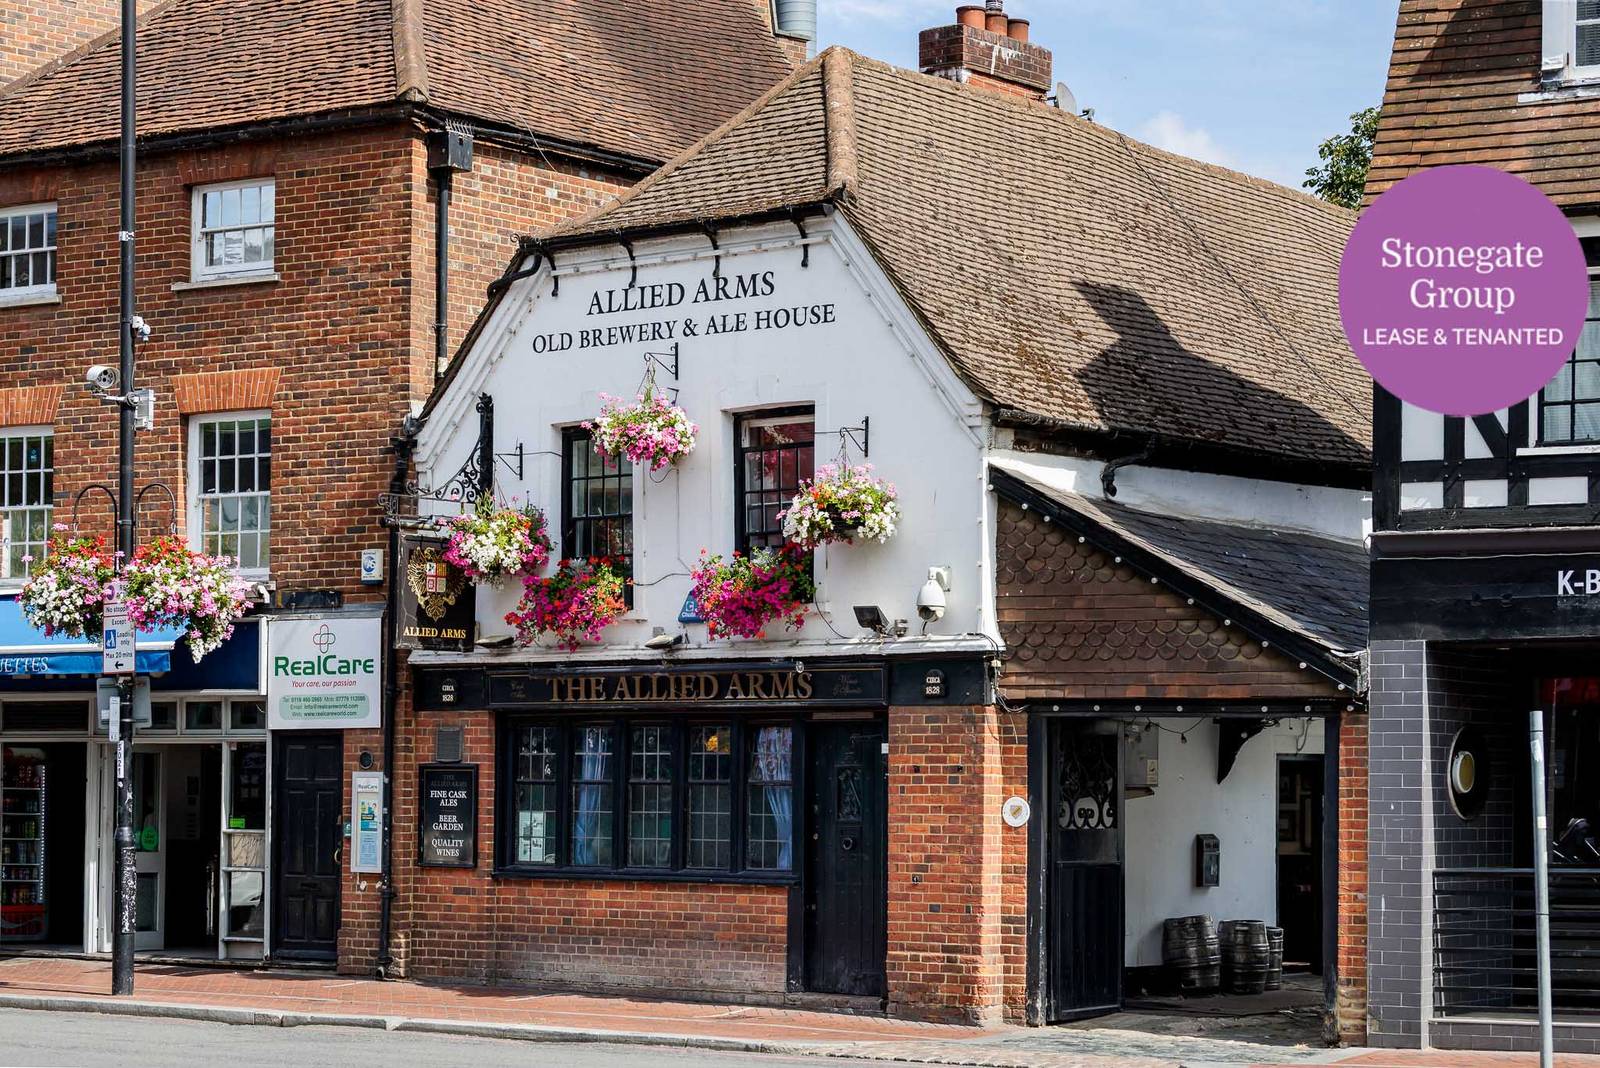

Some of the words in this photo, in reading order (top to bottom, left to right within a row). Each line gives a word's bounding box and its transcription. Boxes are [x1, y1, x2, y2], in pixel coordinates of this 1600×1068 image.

[586, 281, 686, 316] ALLIED
[692, 270, 776, 304] ARMS
[532, 331, 573, 354] OLD
[579, 319, 679, 350] BREWERY
[682, 317, 699, 338] &
[704, 313, 748, 336] ALE
[755, 303, 837, 331] HOUSE
[105, 606, 114, 614] No
[111, 618, 127, 626] Except
[403, 625, 439, 638] ALLIED
[440, 628, 467, 640] ARMS
[115, 651, 122, 659] 20
[274, 655, 374, 677] RealCare
[291, 680, 306, 688] Your
[333, 680, 357, 689] passion
[926, 676, 941, 684] CIRCA
[545, 674, 607, 701] THE
[612, 674, 719, 701] ALLIED
[724, 672, 813, 700] ARMS
[925, 685, 941, 696] 1828
[430, 790, 448, 799] FINE
[448, 790, 468, 799] CASK
[439, 798, 458, 807] ALES
[438, 814, 458, 823] BEER
[432, 822, 464, 831] GARDEN
[431, 838, 465, 848] QUALITY
[436, 848, 460, 857] WINES
